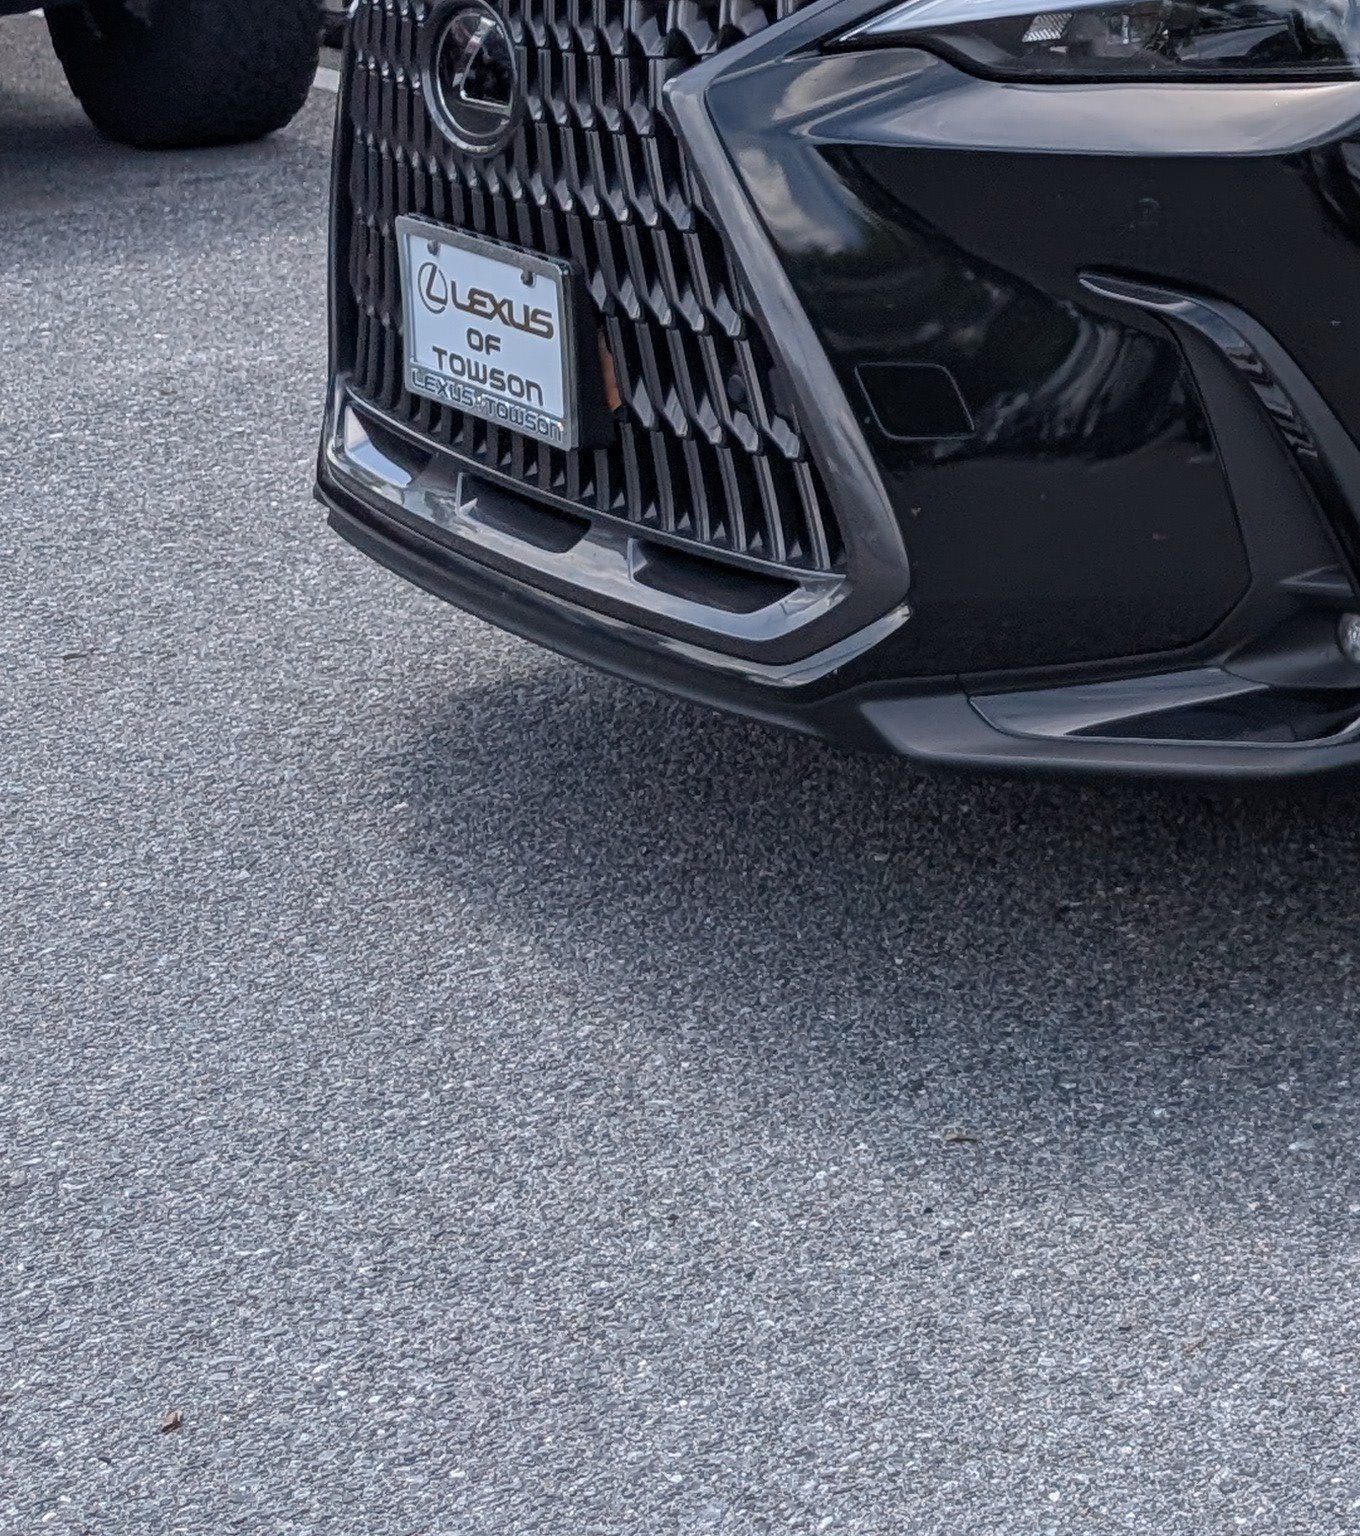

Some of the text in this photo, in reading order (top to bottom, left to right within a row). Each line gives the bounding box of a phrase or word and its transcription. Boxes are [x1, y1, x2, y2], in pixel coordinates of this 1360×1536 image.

[451, 280, 554, 340] LEXUS
[467, 327, 501, 355] OF
[411, 369, 475, 407] LEXUS
